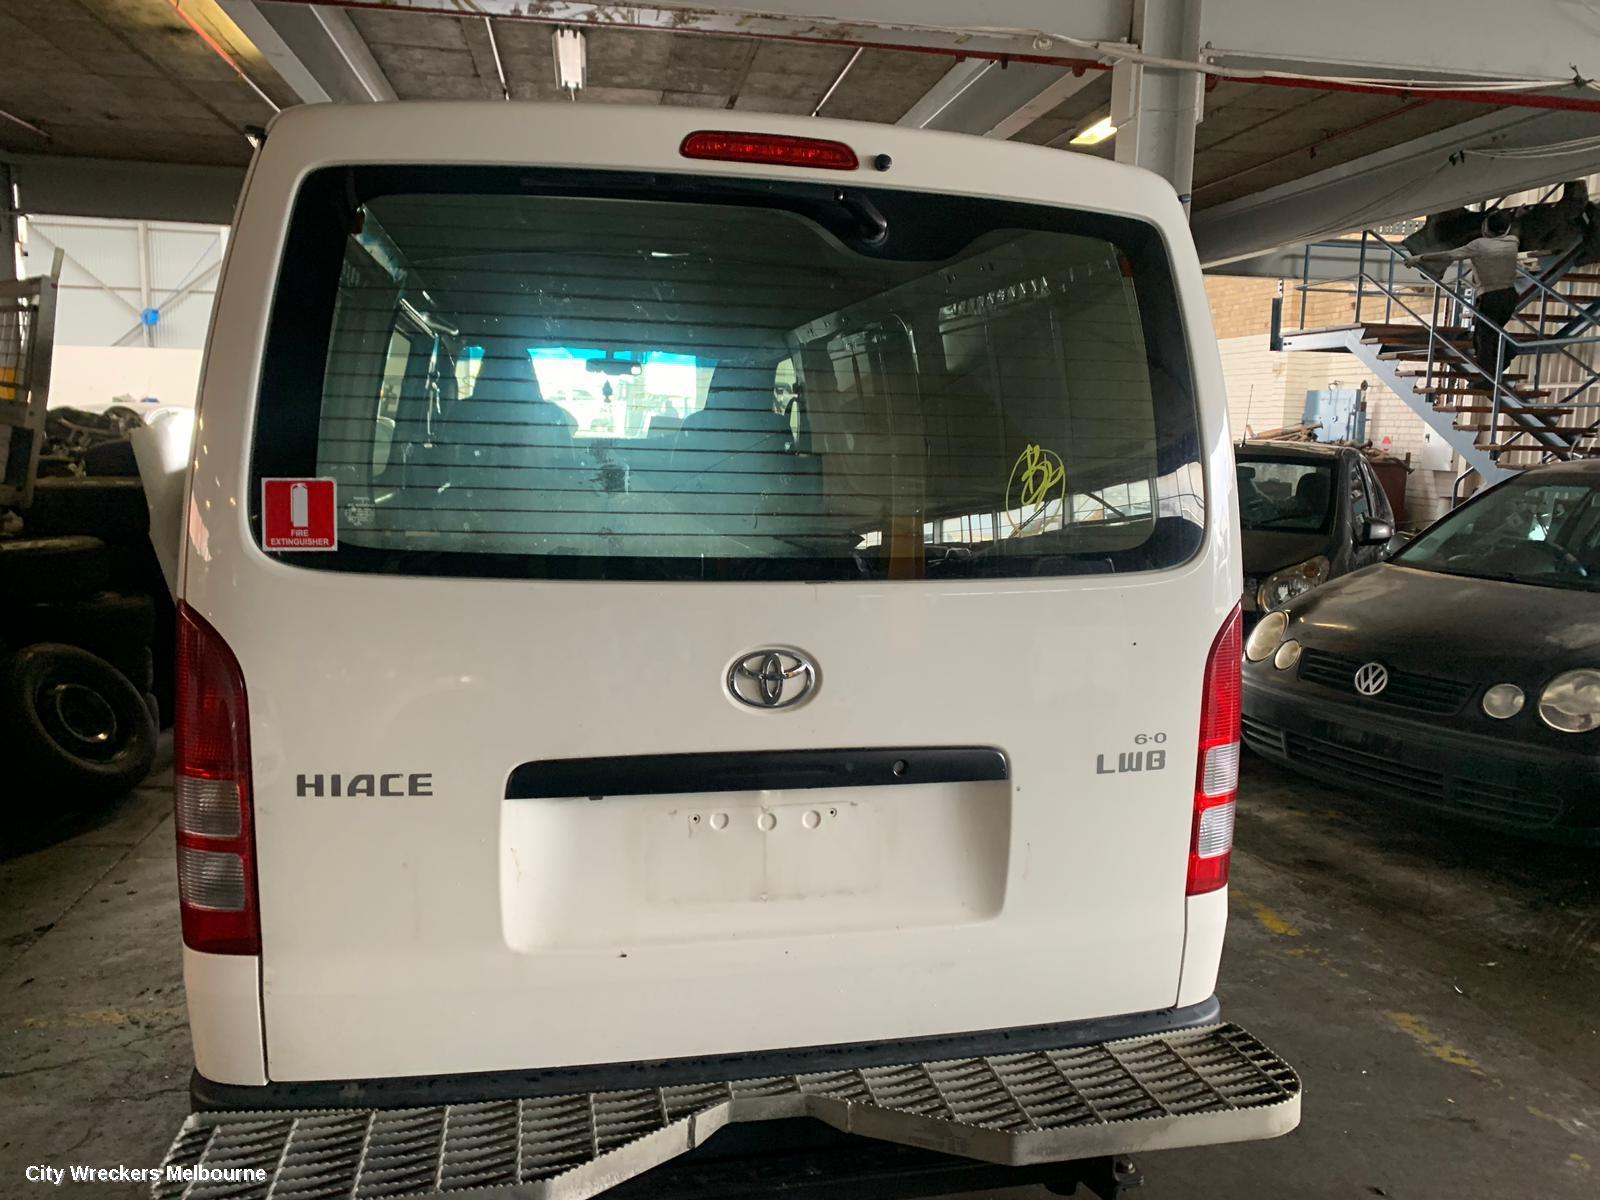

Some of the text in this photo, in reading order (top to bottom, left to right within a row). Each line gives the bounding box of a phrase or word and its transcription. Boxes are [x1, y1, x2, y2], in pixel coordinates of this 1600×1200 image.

[291, 529, 309, 537] FIRE
[271, 538, 329, 546] EXTINGUISHER
[1096, 750, 1166, 774] LWB
[296, 773, 433, 797] HIACE
